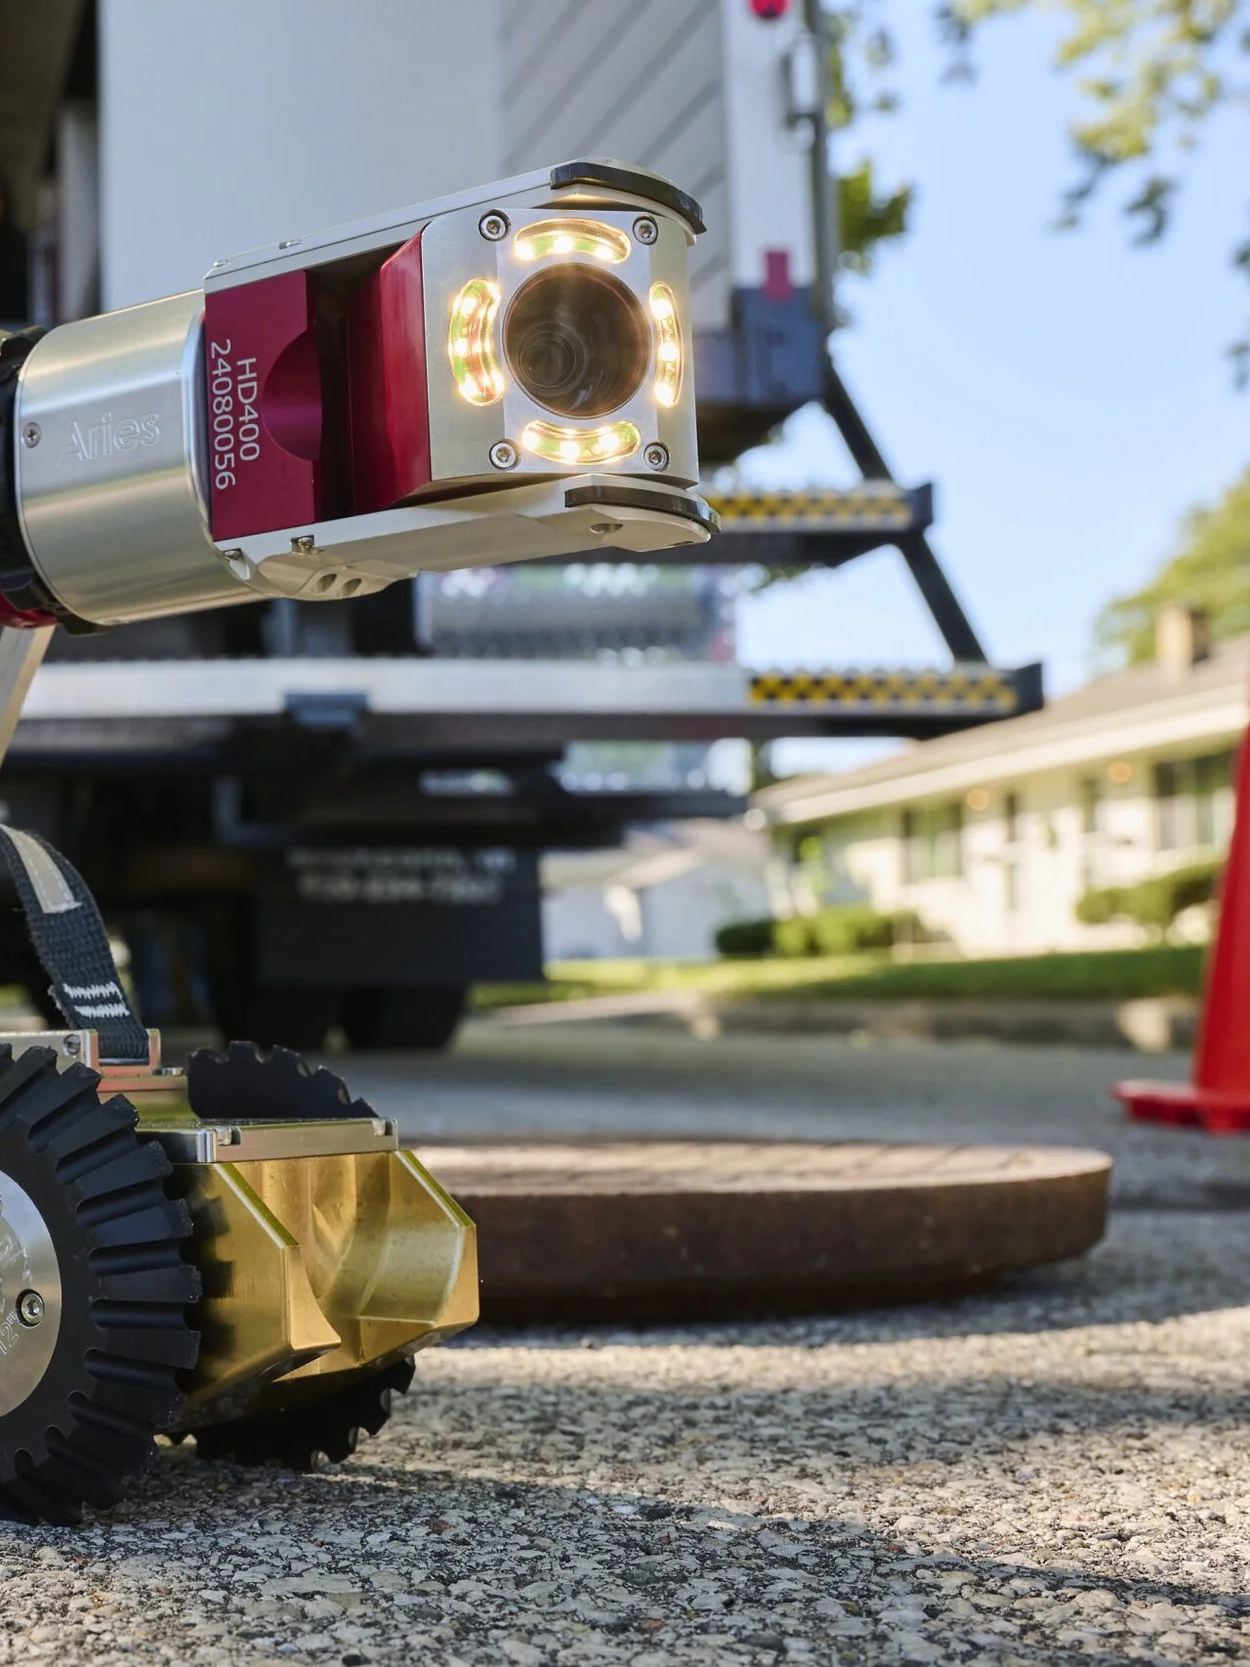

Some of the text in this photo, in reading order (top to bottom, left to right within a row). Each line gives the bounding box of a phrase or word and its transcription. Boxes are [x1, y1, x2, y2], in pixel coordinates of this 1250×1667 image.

[57, 411, 160, 466] Aries
[210, 338, 236, 489] 24080056
[237, 357, 260, 461] HD400
